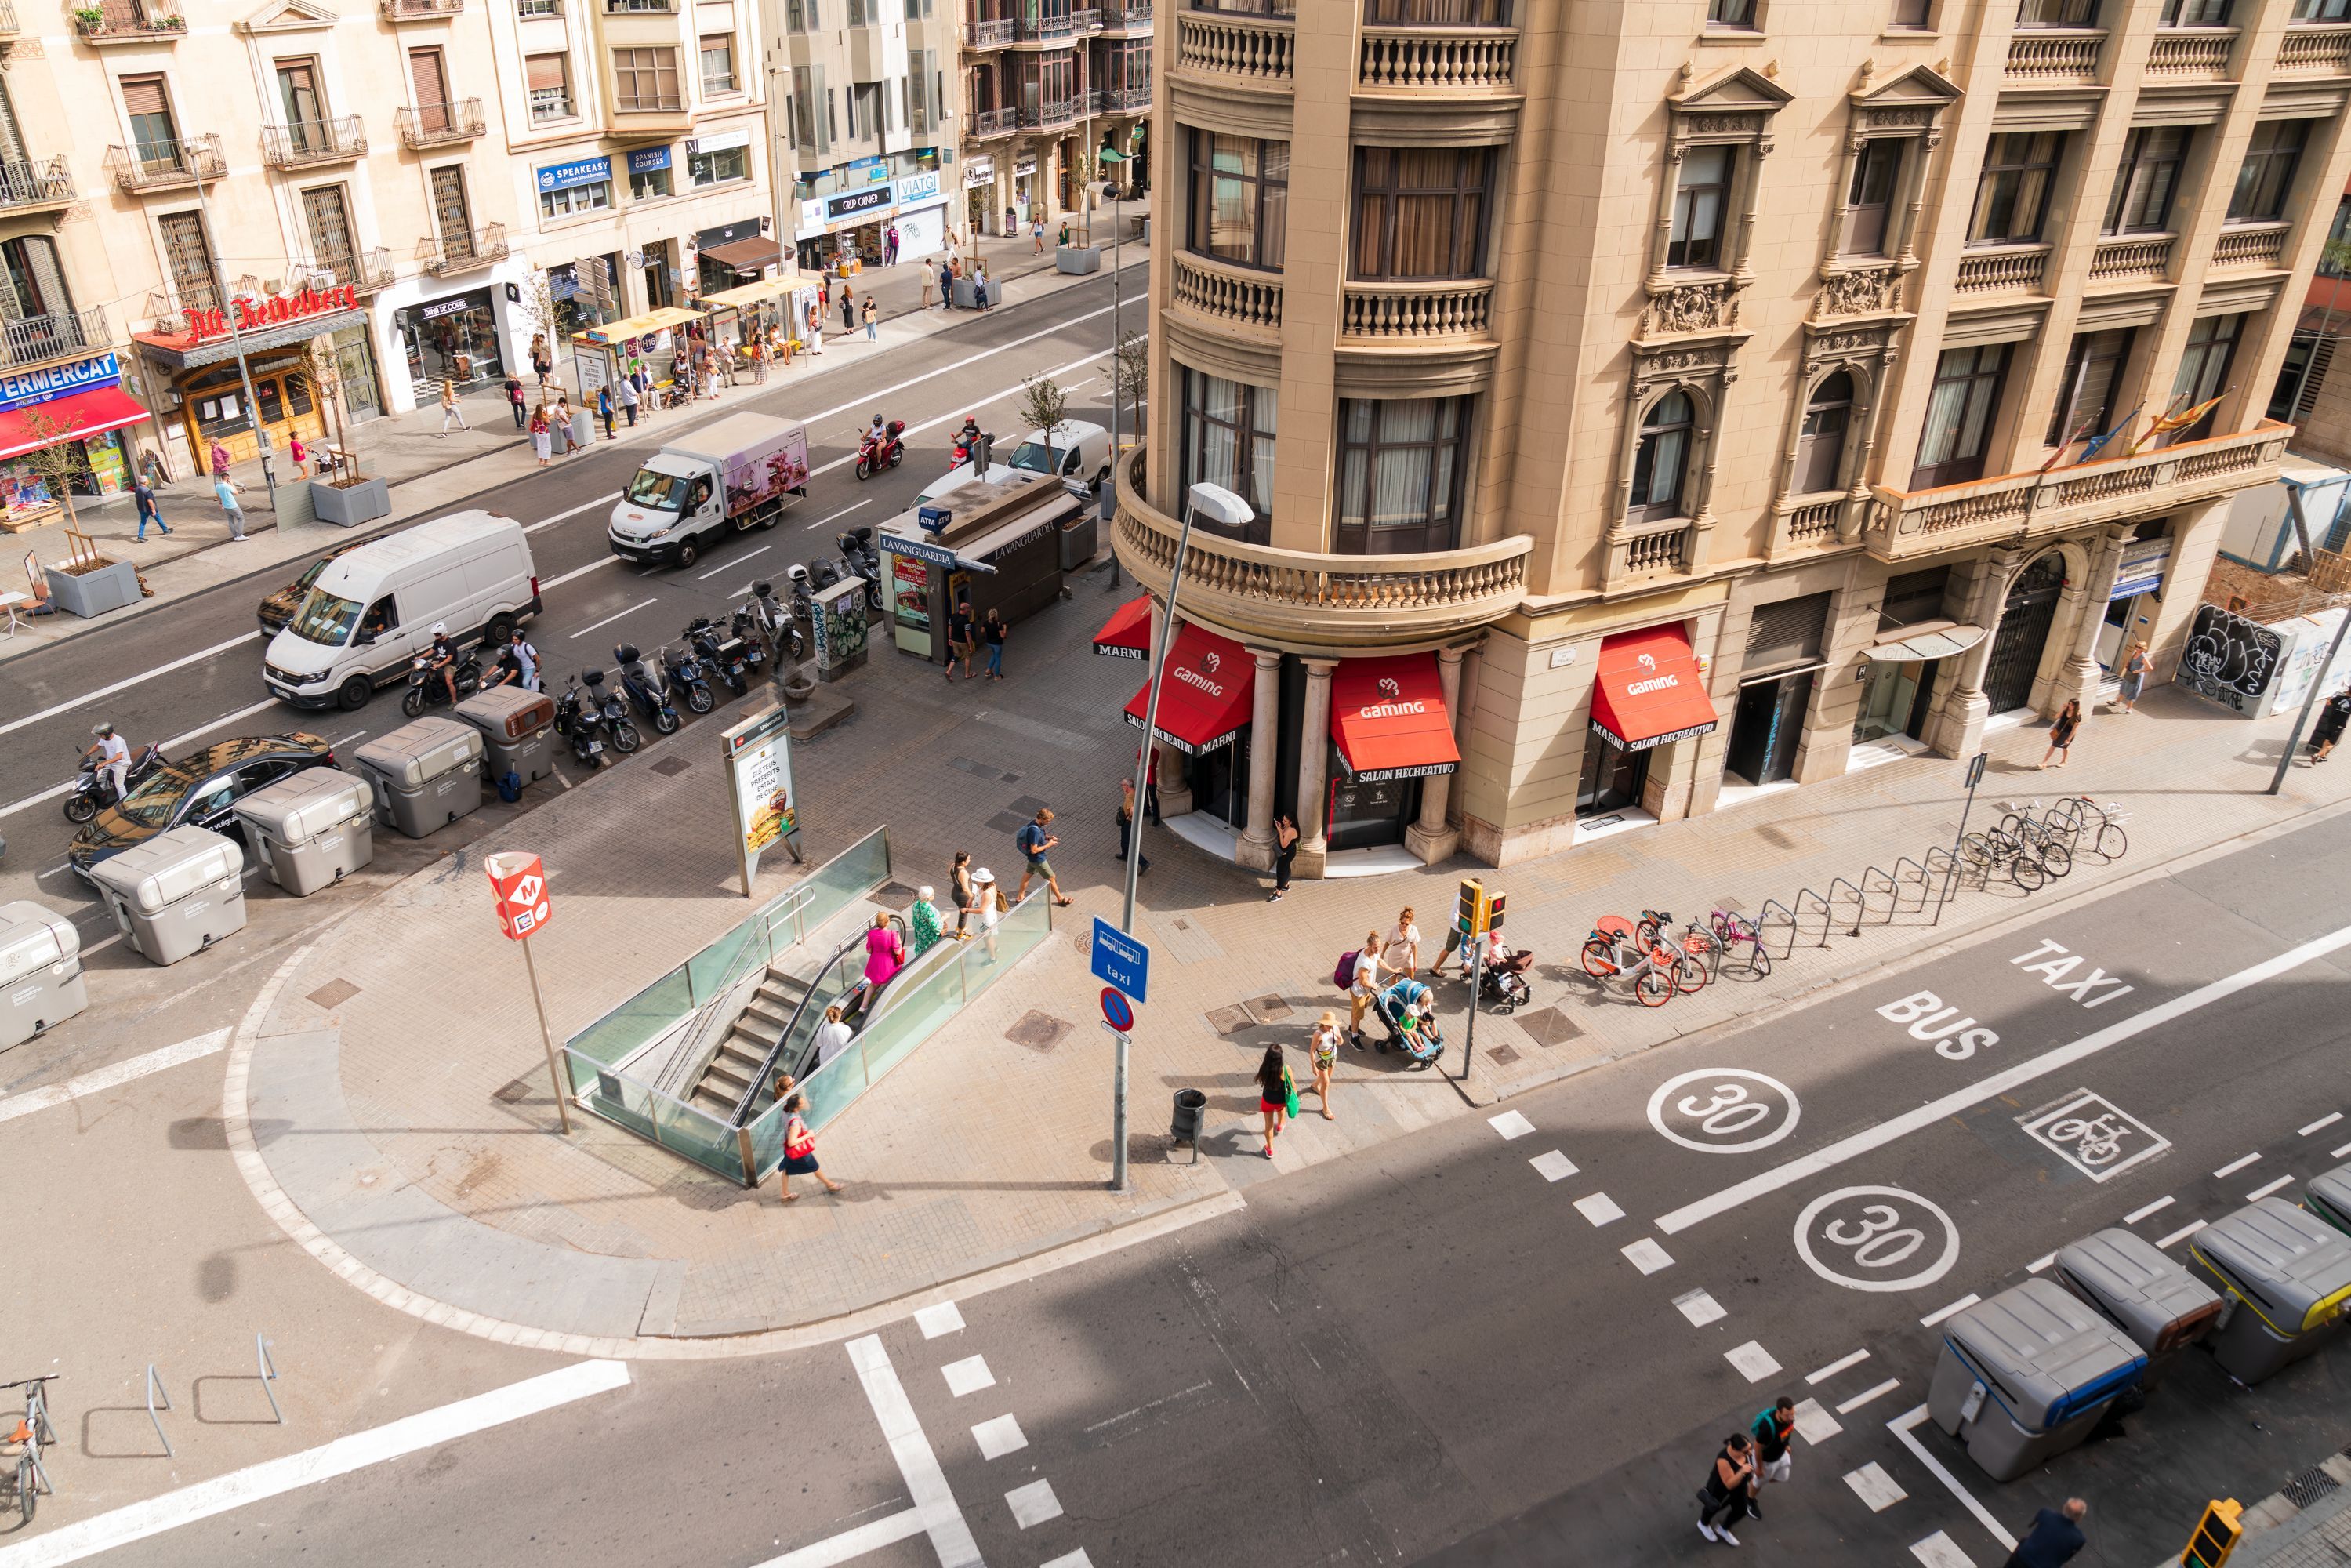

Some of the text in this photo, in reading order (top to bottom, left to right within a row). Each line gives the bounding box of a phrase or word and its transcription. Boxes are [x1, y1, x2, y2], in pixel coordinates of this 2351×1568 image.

[636, 151, 662, 162] SPANISH
[636, 158, 663, 168] COURSES
[557, 162, 608, 178] SPEAKEASY
[902, 175, 936, 194] VIATGI
[843, 198, 857, 210] GRUP
[838, 209, 891, 229] BARCELONA VIBES
[182, 285, 358, 343] Alt Heidelberg
[425, 299, 466, 317] DAMA DE COPAS
[643, 337, 655, 348] H16
[0, 354, 111, 398] ERMERCAT
[920, 516, 935, 526] ATM
[938, 514, 950, 526] ATM
[1099, 644, 1141, 659] MARNI
[1859, 666, 1866, 676] H
[760, 714, 782, 731] Universitat
[1127, 713, 1147, 730] SALO
[1201, 730, 1236, 755] MARNI
[1592, 720, 1625, 751] MARNI
[1630, 723, 1714, 752] SALON RECREATIVO
[753, 759, 777, 779] ELS TEUS
[1337, 746, 1353, 779] MARNI
[750, 766, 781, 788] PREFERITS
[1359, 763, 1454, 782] SALON RECREATIVO
[756, 793, 764, 801] DE
[764, 784, 778, 797] CINE
[757, 778, 775, 792] ESTAN
[521, 880, 537, 901] M
[1107, 964, 1130, 986] taxi
[2009, 938, 2135, 1009] TAXI
[1875, 990, 2000, 1060] BUS
[1678, 1083, 1769, 1134] 30
[1825, 1205, 1925, 1267] 30
